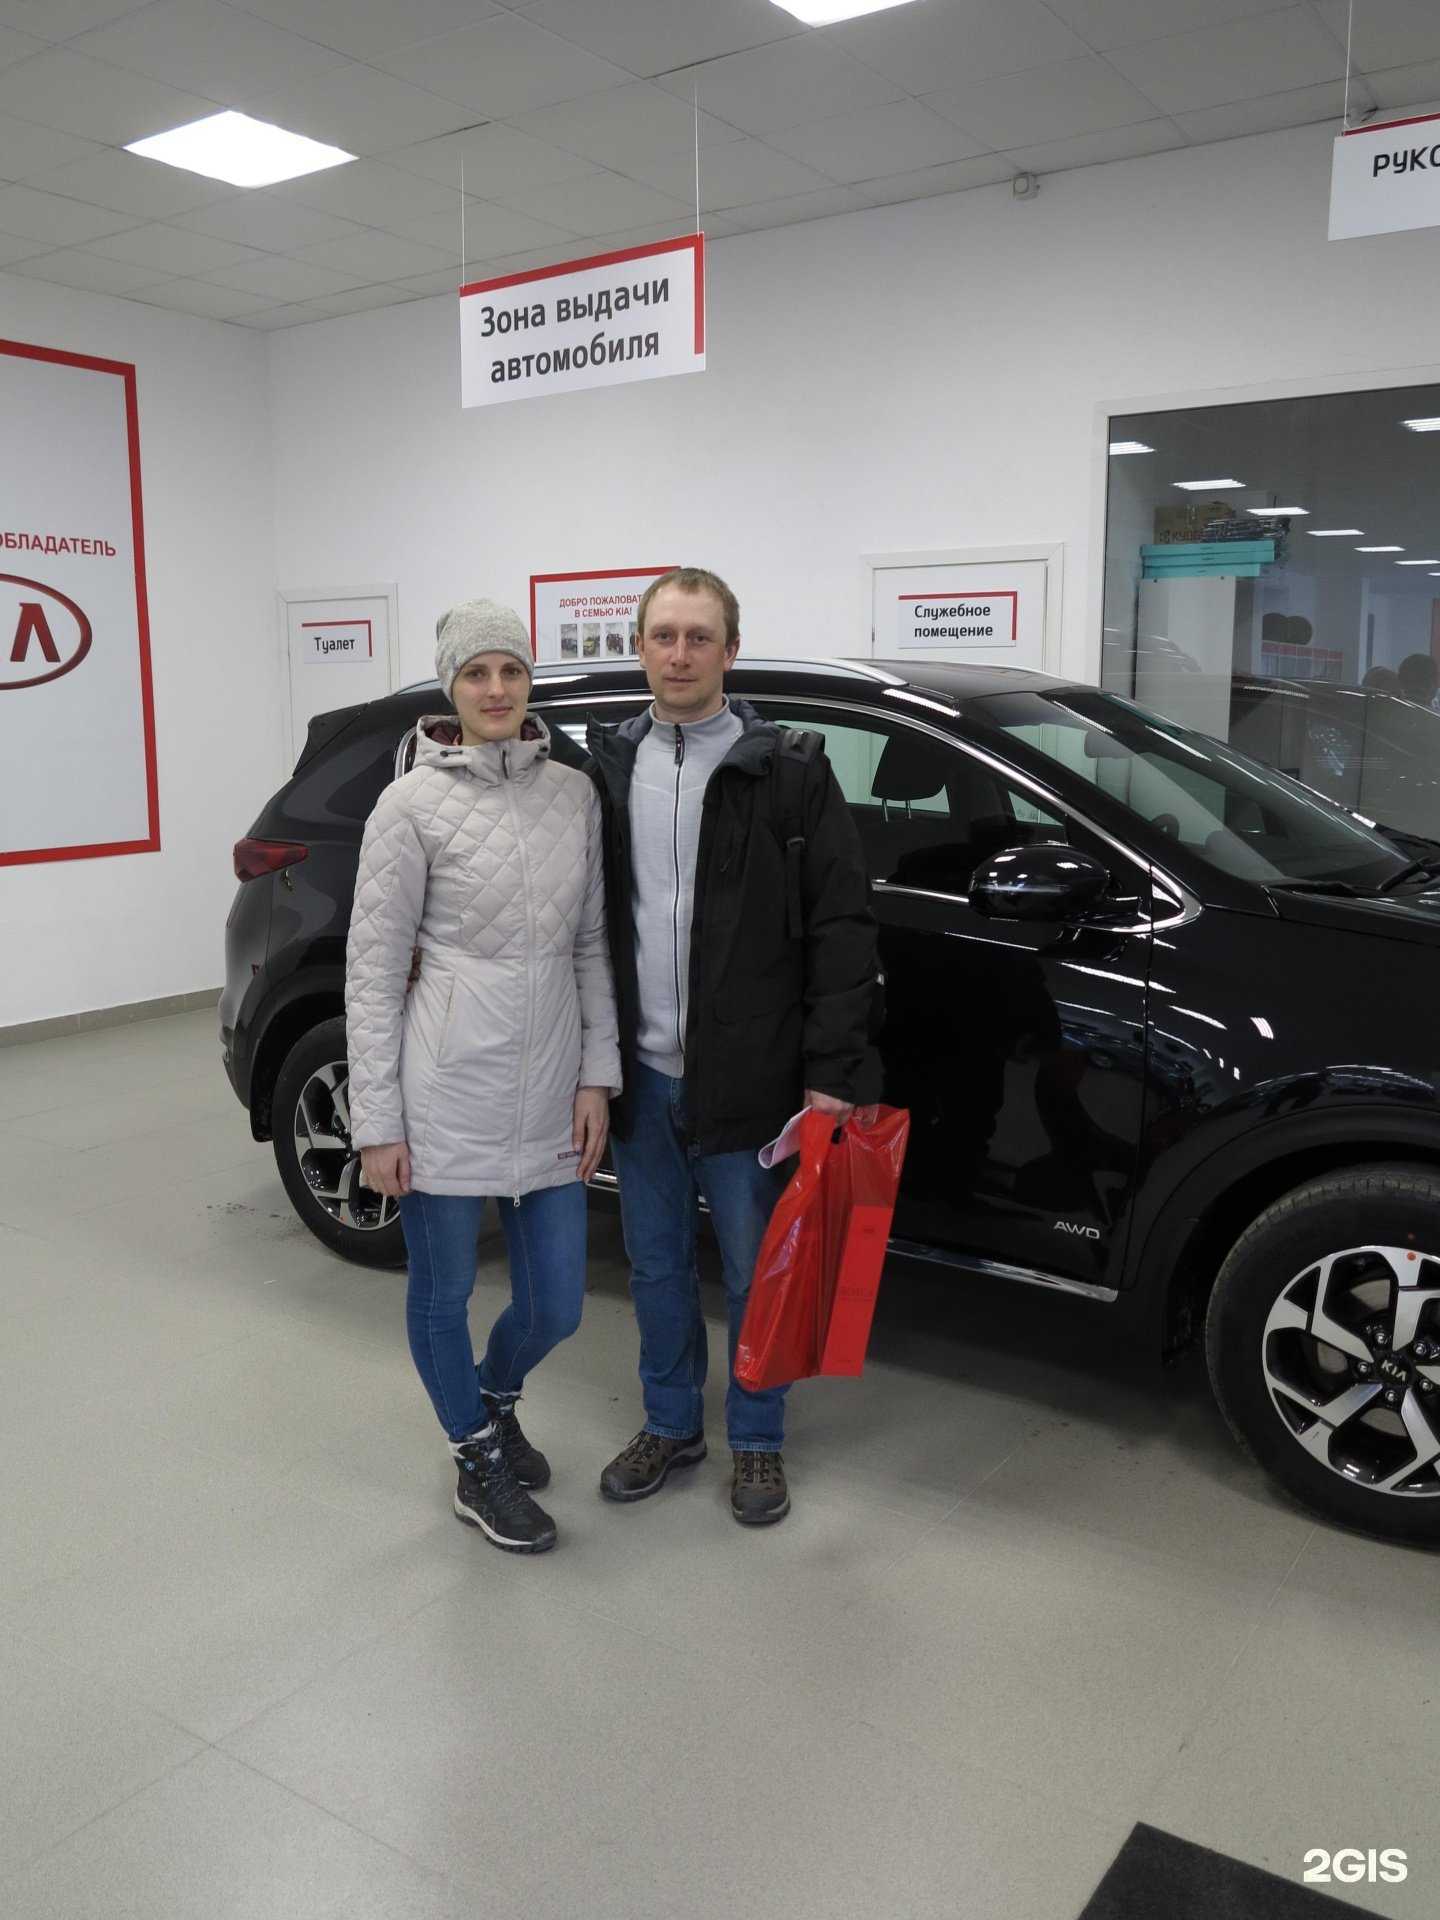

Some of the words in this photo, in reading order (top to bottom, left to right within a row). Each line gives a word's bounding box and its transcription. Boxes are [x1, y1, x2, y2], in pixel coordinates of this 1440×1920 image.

[480, 302, 546, 338] Зона
[556, 277, 670, 323] выдачи
[490, 331, 660, 384] автомобиля
[0, 532, 117, 557] БЛАДАТЕЛЬ
[559, 597, 588, 608] ДОБРО
[914, 603, 991, 621] Служебное
[574, 608, 580, 618] В
[582, 607, 614, 617] СЕМЬЮ
[914, 625, 994, 640] помещение
[313, 636, 356, 654] Туалет
[1053, 1220, 1100, 1240] AWD
[1381, 1359, 1407, 1382] KIA
